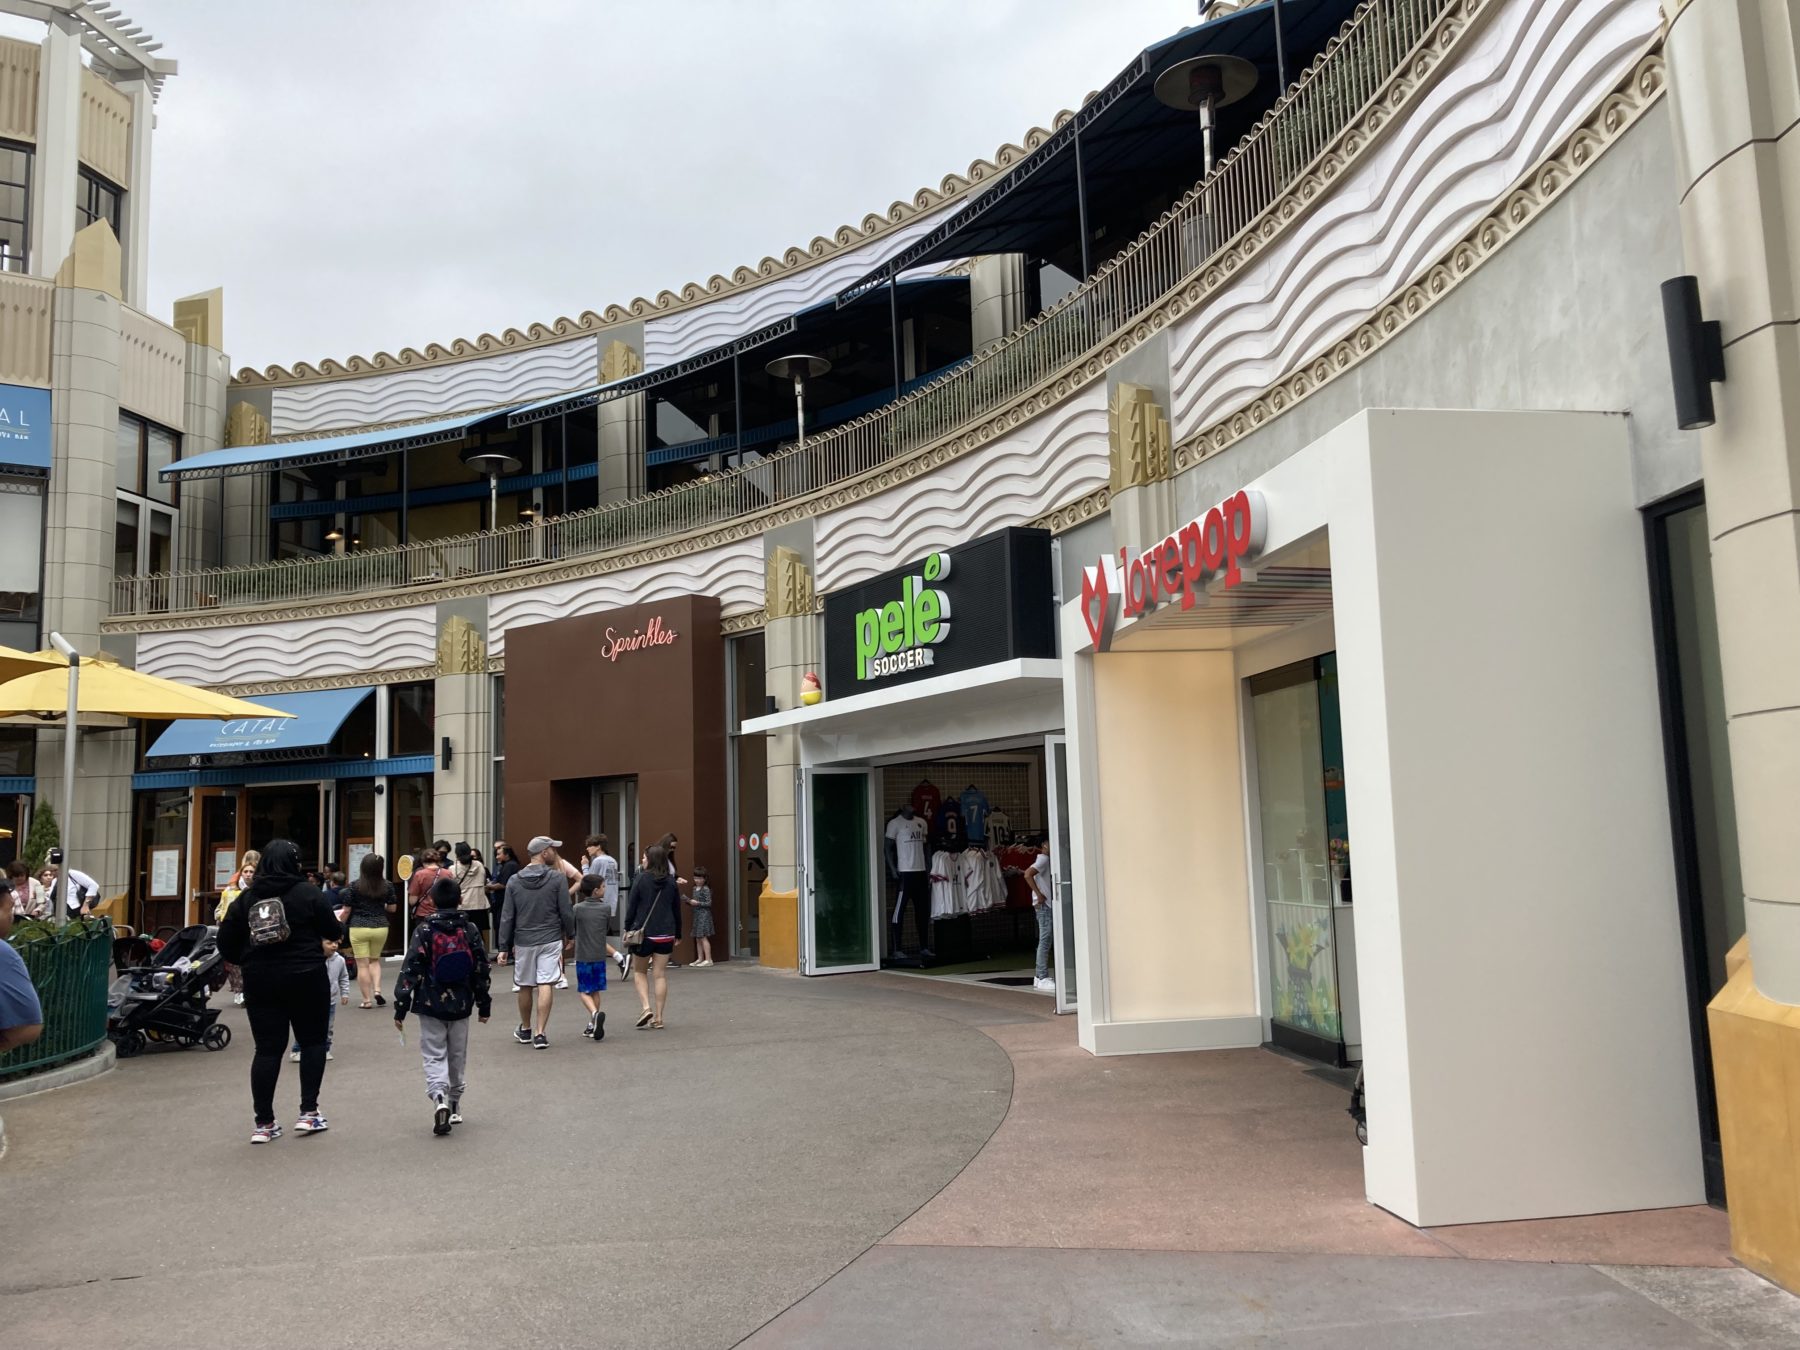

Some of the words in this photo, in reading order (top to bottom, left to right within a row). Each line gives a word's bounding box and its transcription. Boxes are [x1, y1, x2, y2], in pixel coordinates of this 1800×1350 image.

[1120, 489, 1252, 619] lovepop
[856, 552, 946, 681] pelé
[601, 615, 679, 662] Sprinkles
[874, 648, 930, 677] SOCCER
[221, 718, 289, 735] CATAL
[970, 805, 978, 823] 7
